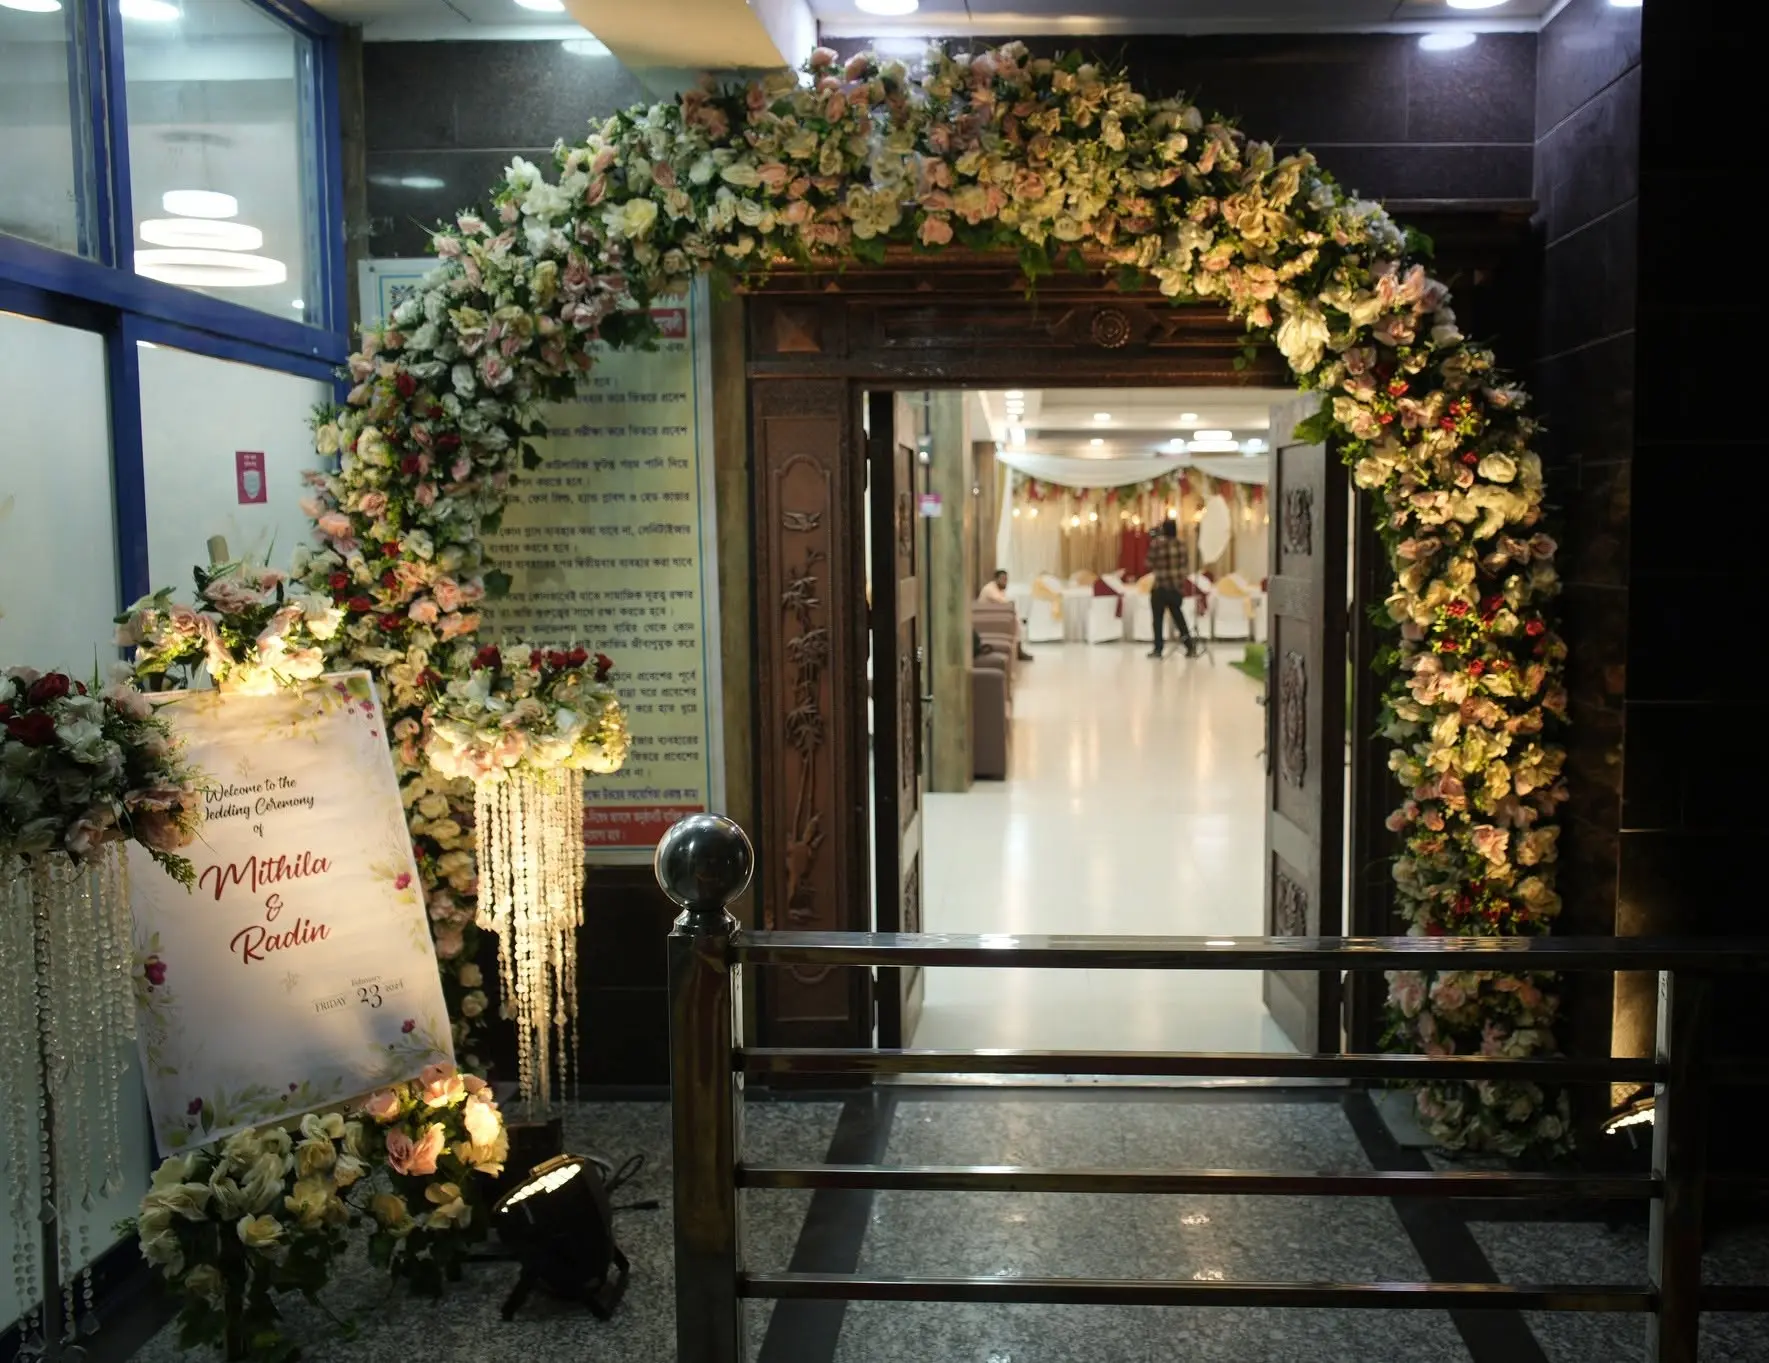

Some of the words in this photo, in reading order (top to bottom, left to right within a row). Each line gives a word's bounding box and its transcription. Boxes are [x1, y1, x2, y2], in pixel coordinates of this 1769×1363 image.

[204, 784, 262, 804] Welcome
[264, 779, 276, 792] to
[279, 776, 297, 790] the
[255, 795, 315, 817] Ceremony
[253, 823, 264, 837] of
[199, 850, 332, 901] Mithila
[265, 893, 284, 922] &
[230, 918, 331, 964] Radin
[315, 996, 347, 1013] FRIDAY
[357, 984, 383, 1009] 23
